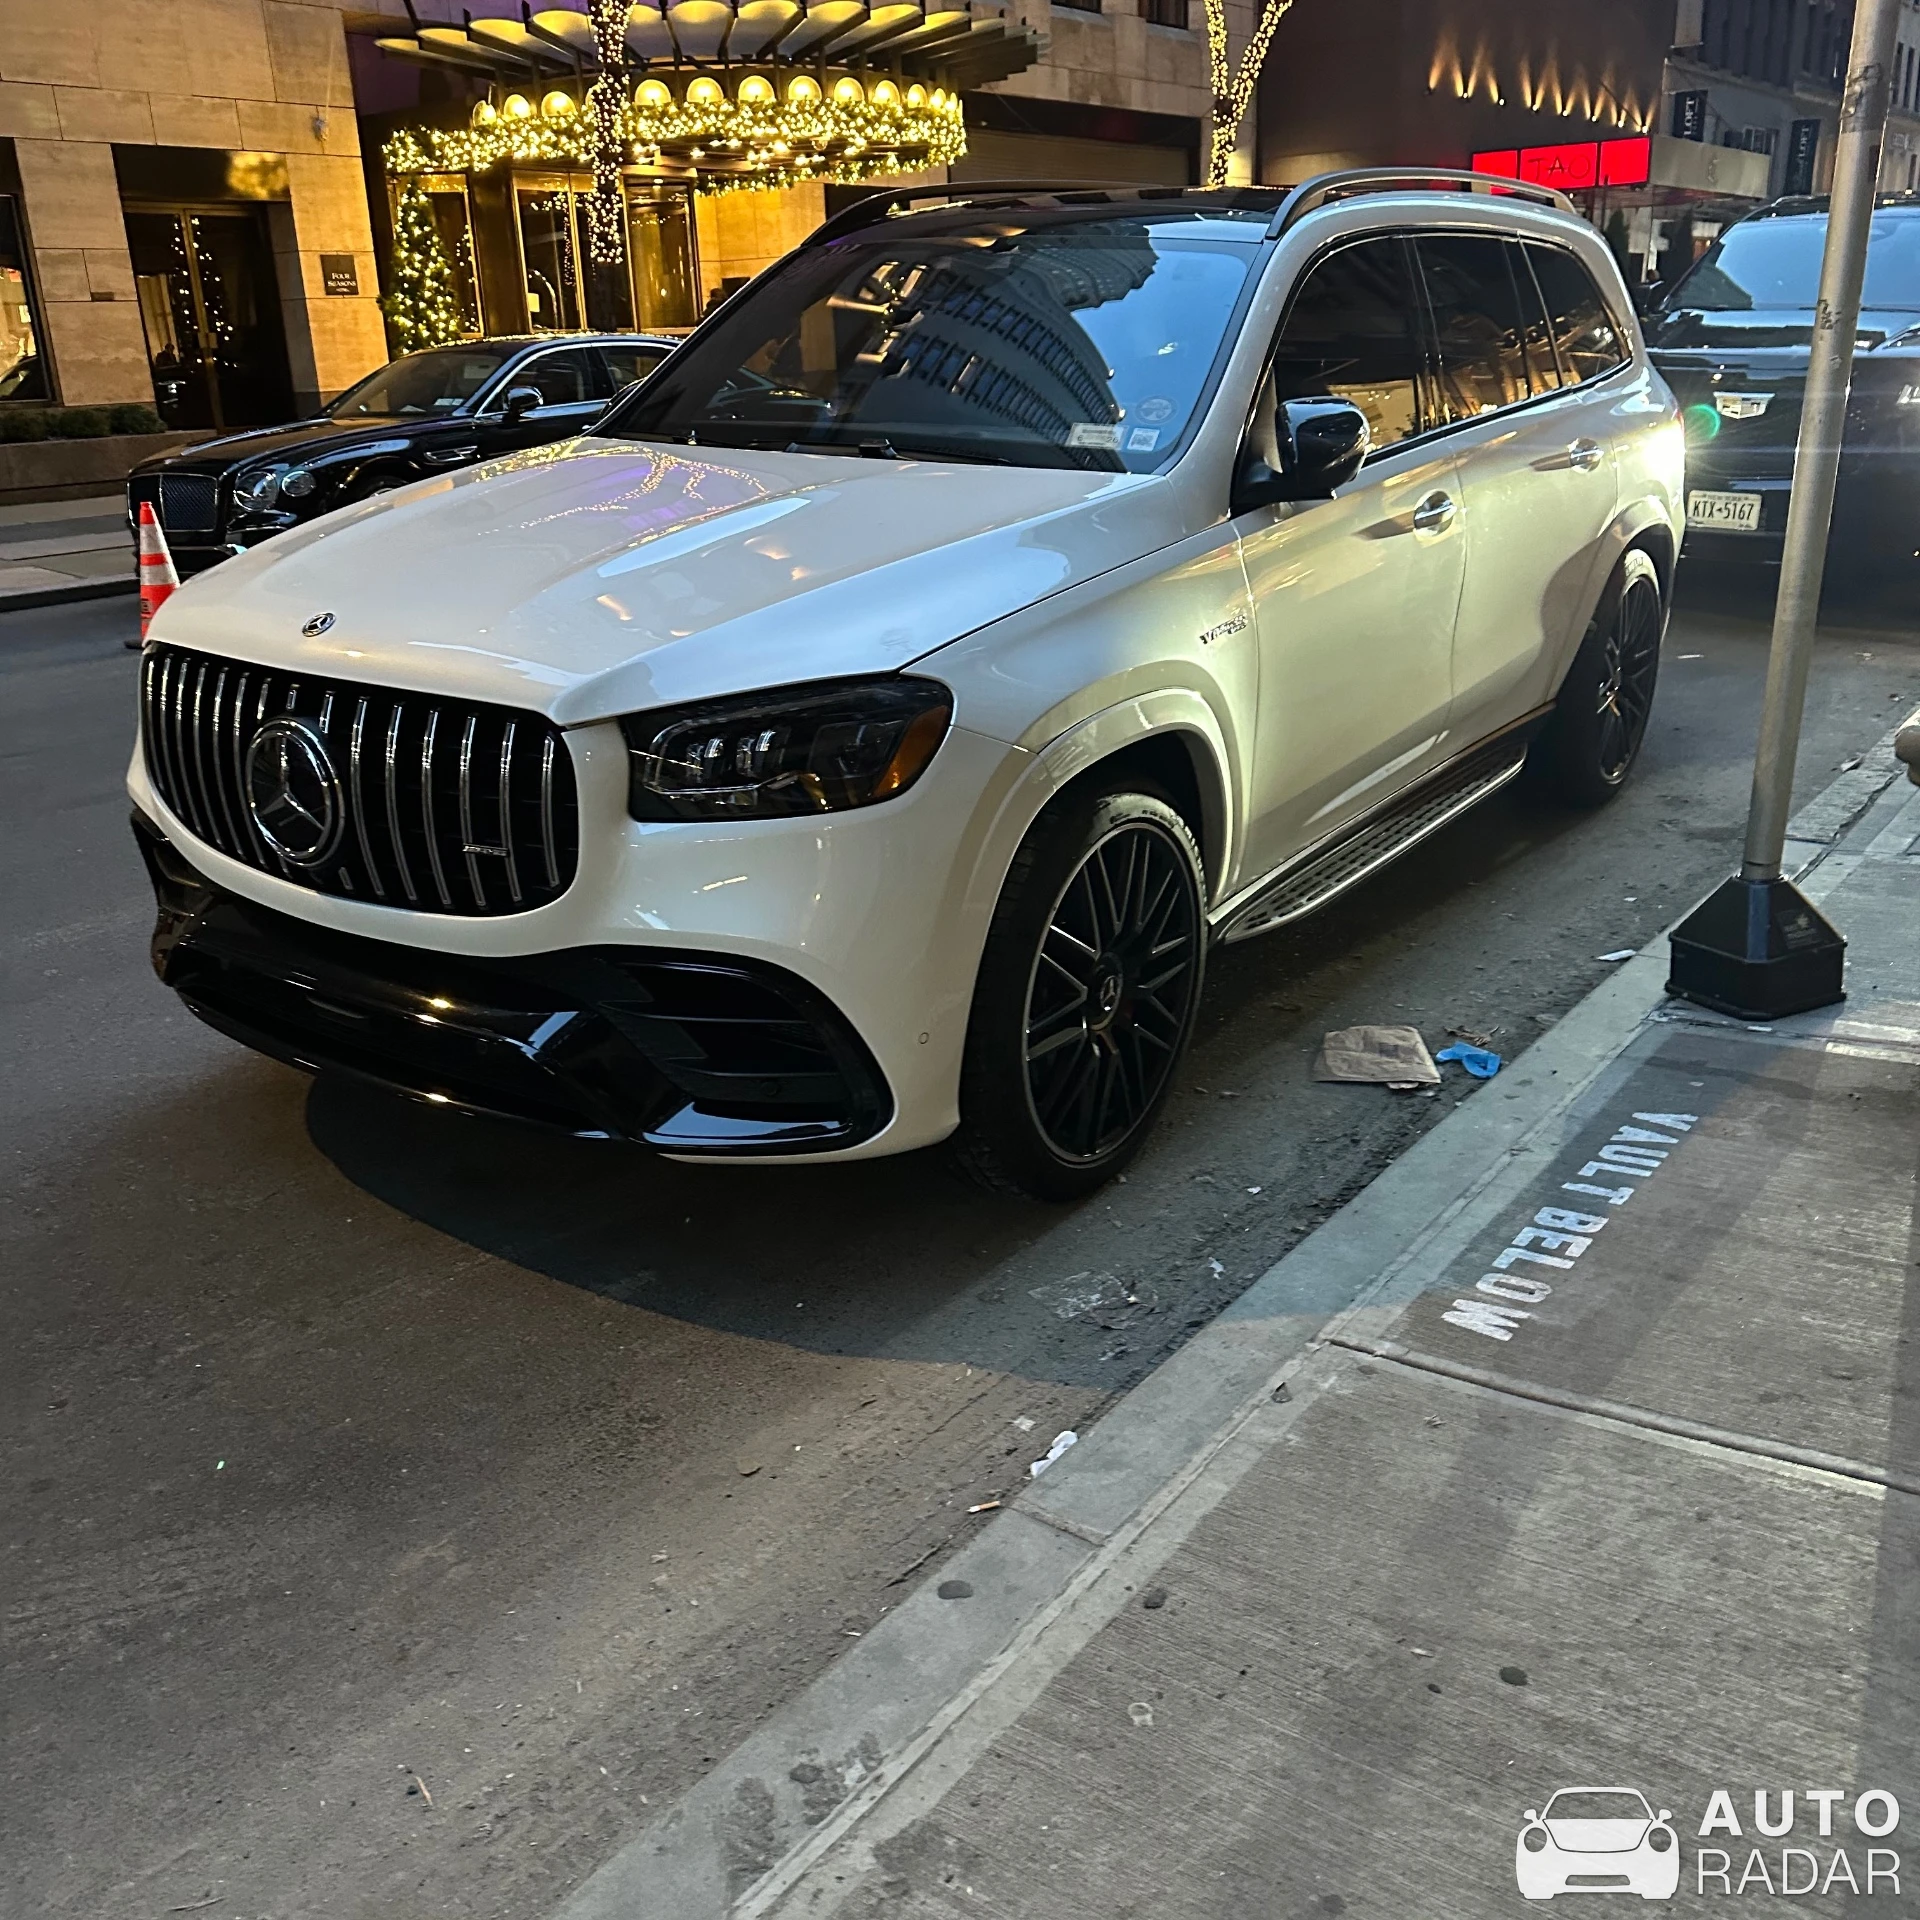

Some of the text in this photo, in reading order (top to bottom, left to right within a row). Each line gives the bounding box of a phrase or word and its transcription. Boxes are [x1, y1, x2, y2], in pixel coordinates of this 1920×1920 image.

[1528, 154, 1591, 183] TAO
[331, 272, 350, 280] FOUR
[1440, 1111, 1699, 1341] VAULT BELOW
